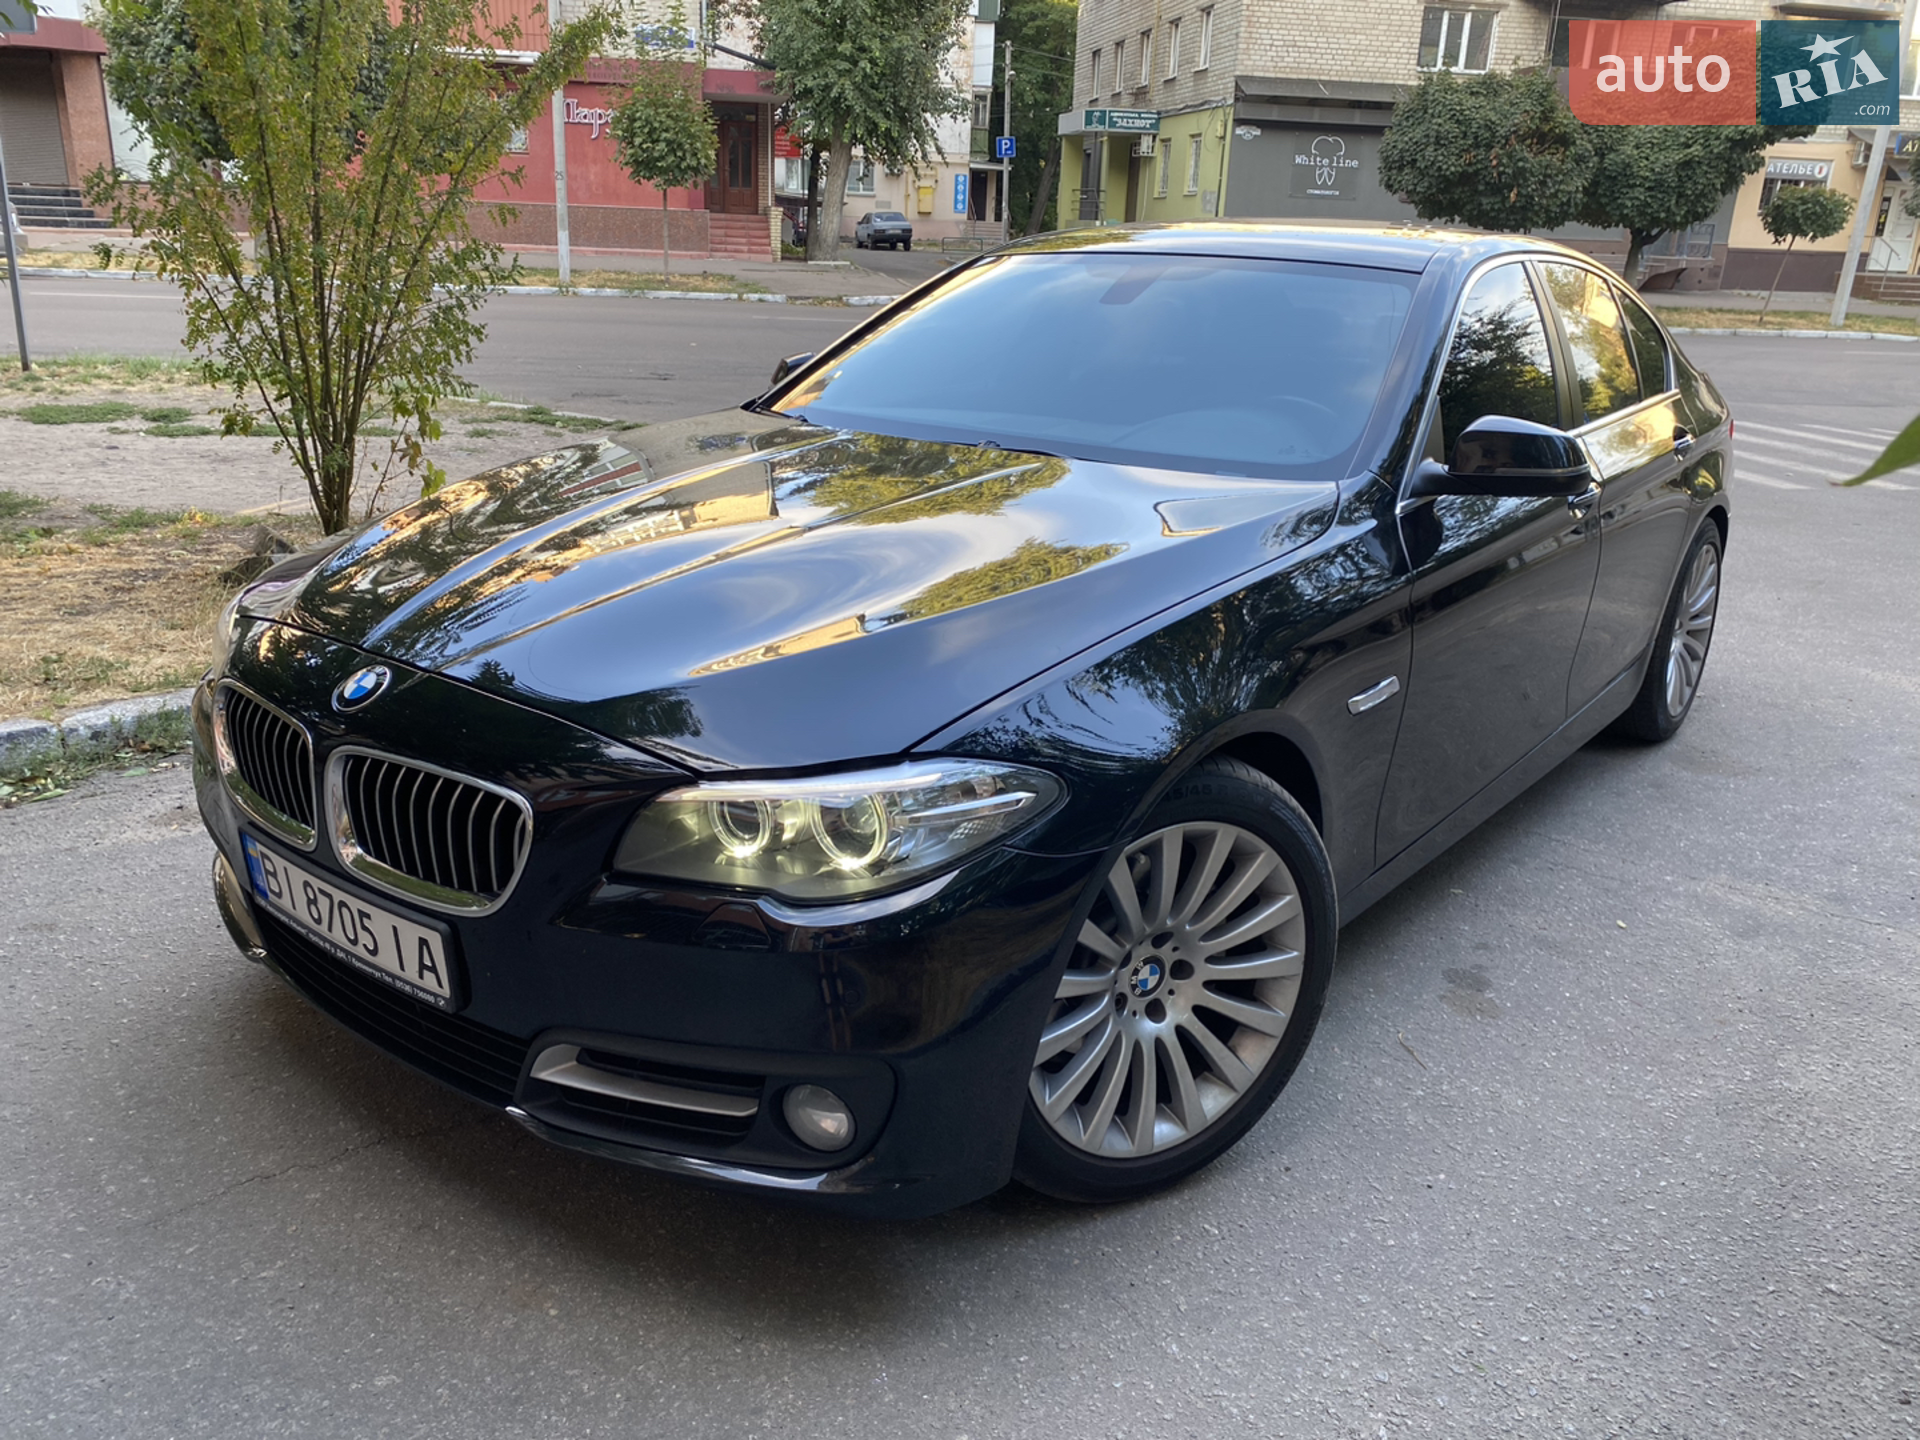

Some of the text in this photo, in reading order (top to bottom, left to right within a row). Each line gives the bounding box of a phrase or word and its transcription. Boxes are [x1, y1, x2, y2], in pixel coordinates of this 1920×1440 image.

[1002, 139, 1011, 155] P
[1295, 154, 1359, 168] White line
[1767, 162, 1813, 175] АТЕЛЬЕ
[260, 850, 297, 910] BI
[303, 880, 379, 957] 8705
[392, 924, 444, 989] IA
